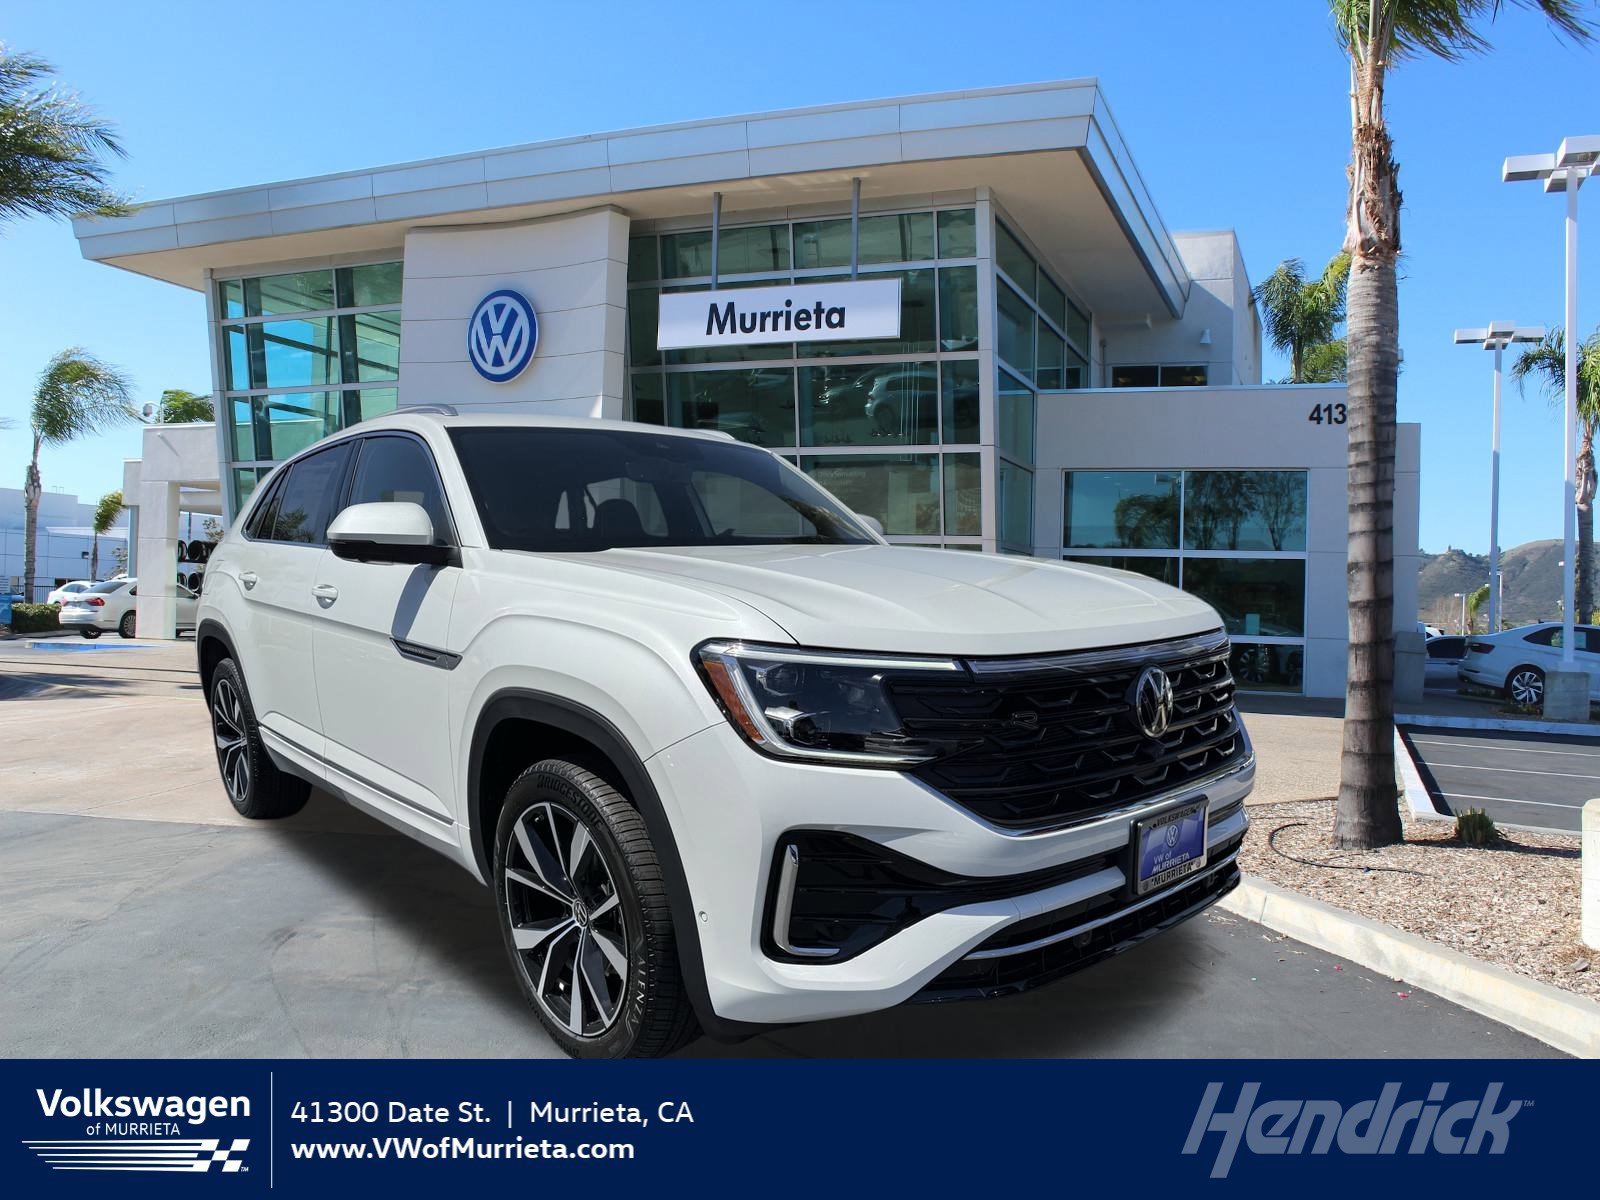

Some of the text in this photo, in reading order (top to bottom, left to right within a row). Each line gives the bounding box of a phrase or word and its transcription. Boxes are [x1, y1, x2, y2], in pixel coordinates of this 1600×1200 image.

[705, 298, 847, 337] Murrieta
[536, 774, 604, 831] BRIDGESTONE
[1156, 807, 1195, 827] VOLKSWAGEN
[1151, 852, 1191, 875] MURRIETA
[1153, 853, 1165, 865] VW
[1153, 863, 1193, 887] MURRIETA
[631, 954, 647, 1025] ALENZA
